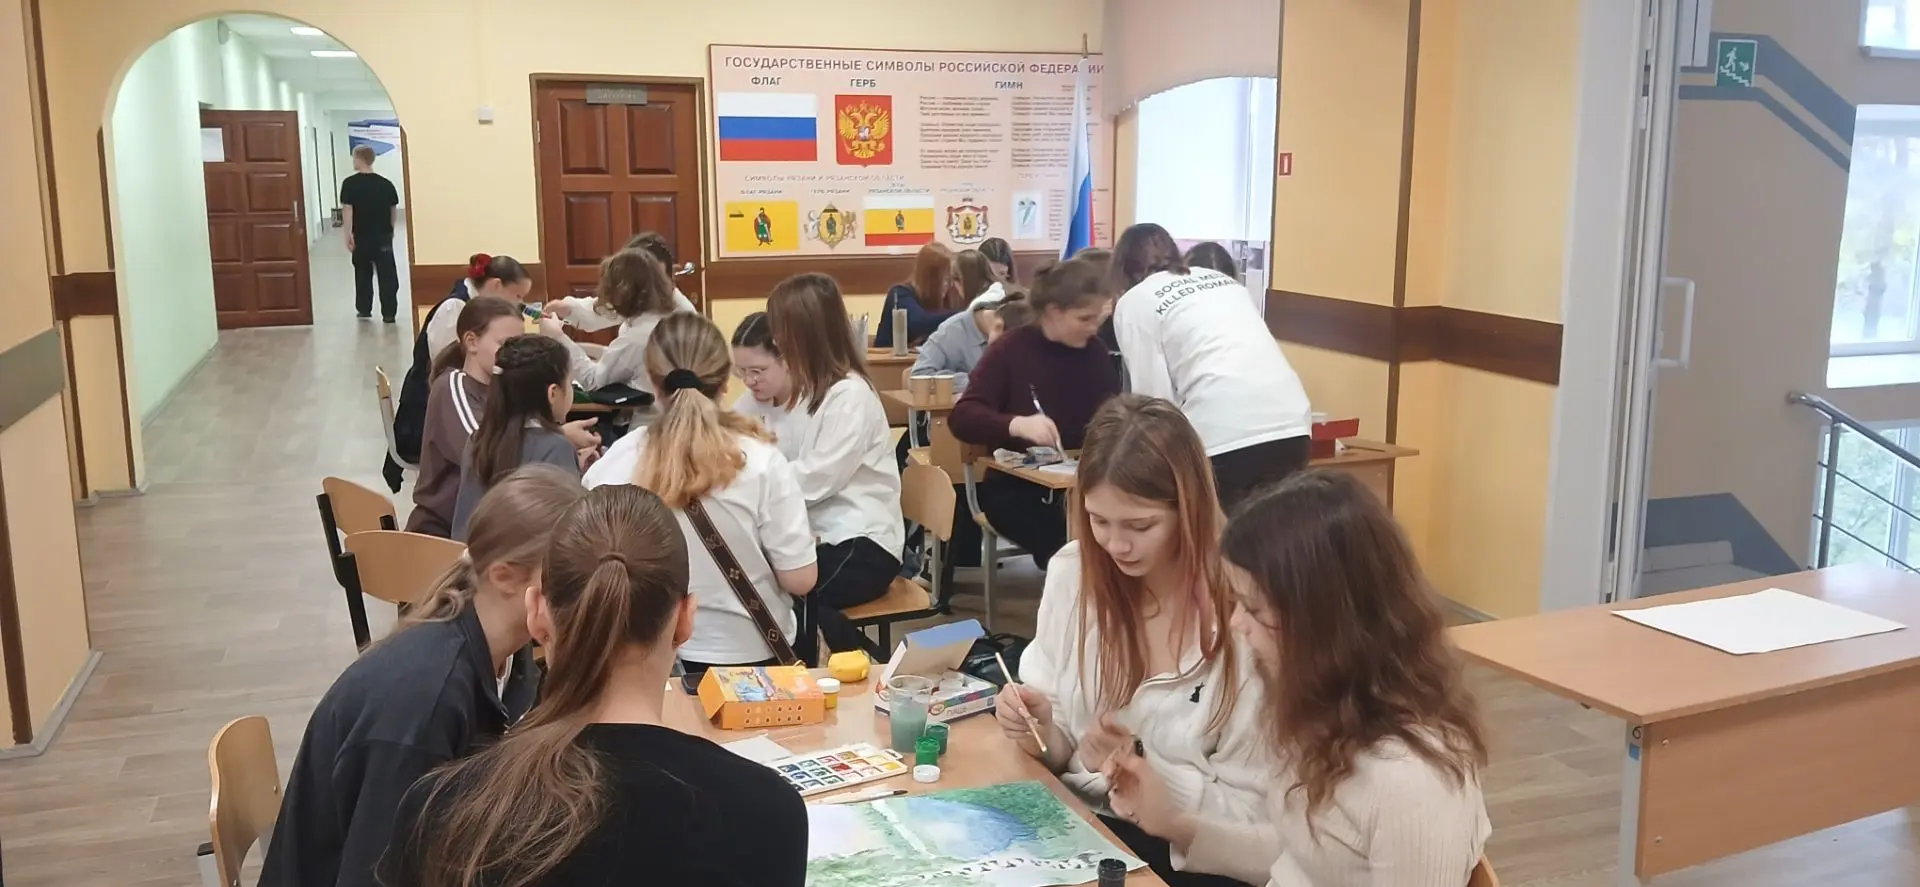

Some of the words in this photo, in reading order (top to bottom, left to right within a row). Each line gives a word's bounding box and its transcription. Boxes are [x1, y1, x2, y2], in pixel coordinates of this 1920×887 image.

[725, 56, 862, 71] ГОСУДАРСТВЕННЫЕ
[866, 60, 935, 73] СИМВОЛЫ
[939, 60, 1026, 74] РОССИЙСКОЙ
[1029, 63, 1105, 75] ФЕДЕРАИИ
[751, 76, 783, 86] ФЛАГ
[850, 78, 877, 88] ГЕРБ
[994, 80, 1024, 90] ГИМН
[1155, 277, 1197, 299] SOCIAL
[1156, 286, 1196, 315] KILLED
